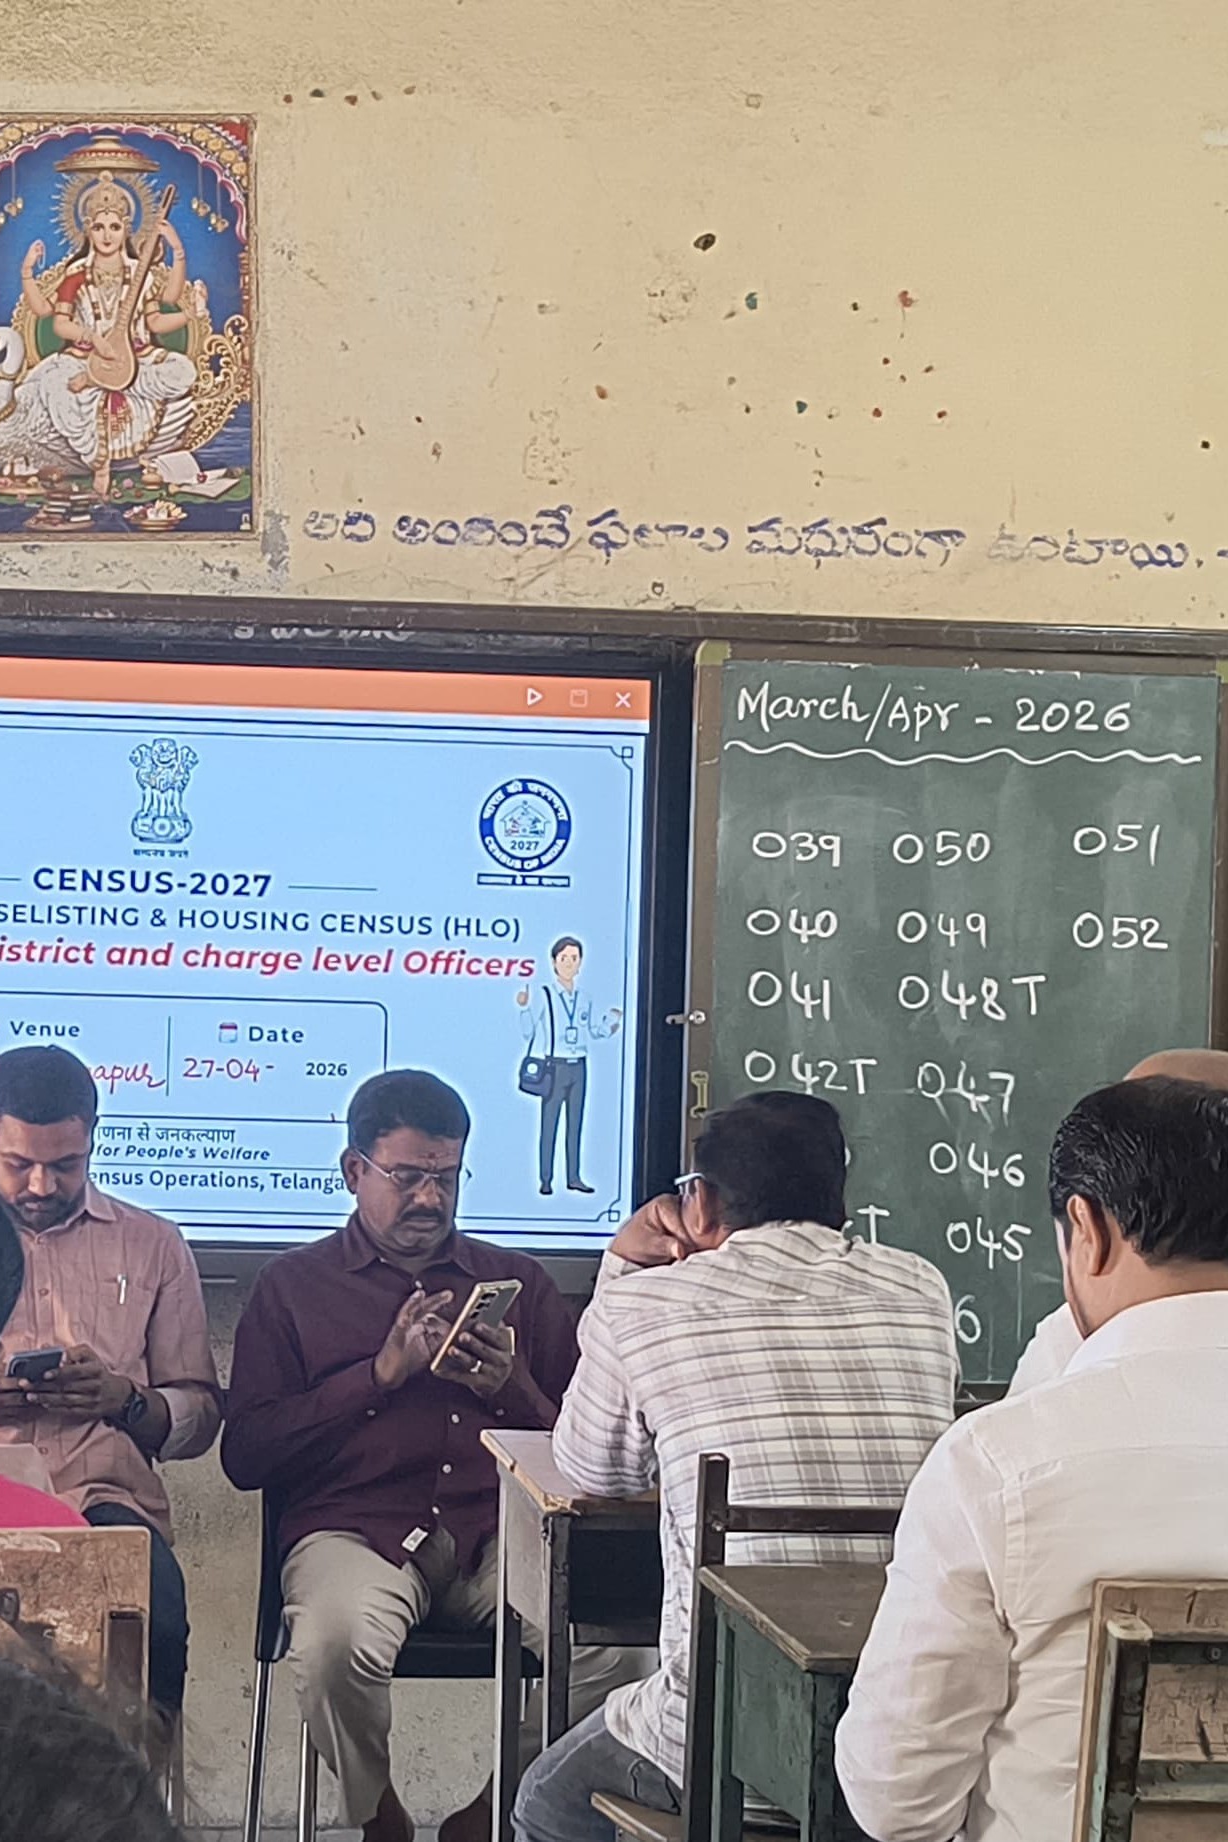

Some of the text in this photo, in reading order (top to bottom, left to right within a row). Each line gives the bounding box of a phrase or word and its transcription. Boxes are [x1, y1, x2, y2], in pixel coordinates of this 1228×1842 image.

[1016, 698, 1132, 732] 2026
[510, 840, 540, 851] 2027
[752, 832, 842, 867] 039
[892, 831, 991, 867] 050
[1073, 825, 1161, 866] 051
[33, 867, 272, 897] CENSUS-2027
[150, 908, 168, 927] &
[179, 909, 310, 932] HOUSING
[321, 913, 434, 936] CENSUS
[444, 916, 521, 943] (HLO)
[746, 910, 839, 944] 040
[897, 911, 988, 948] 049
[1073, 911, 1169, 949] 052
[106, 942, 174, 967] and
[182, 943, 303, 976] charge
[312, 947, 394, 974] level
[403, 949, 536, 978] Officers
[747, 970, 831, 1021] 041
[10, 1020, 81, 1037] Venue
[248, 1026, 305, 1043] Date
[88, 1062, 166, 1094] apur
[306, 1062, 348, 1077] 2026
[917, 1060, 1016, 1113] 047
[137, 1122, 151, 1142] से
[125, 1145, 197, 1163] People's
[203, 1147, 271, 1161] Welfare
[929, 1142, 1026, 1188] 046
[88, 1170, 346, 1194] ensus Operations, Telanga
[946, 1217, 1032, 1270] 045
